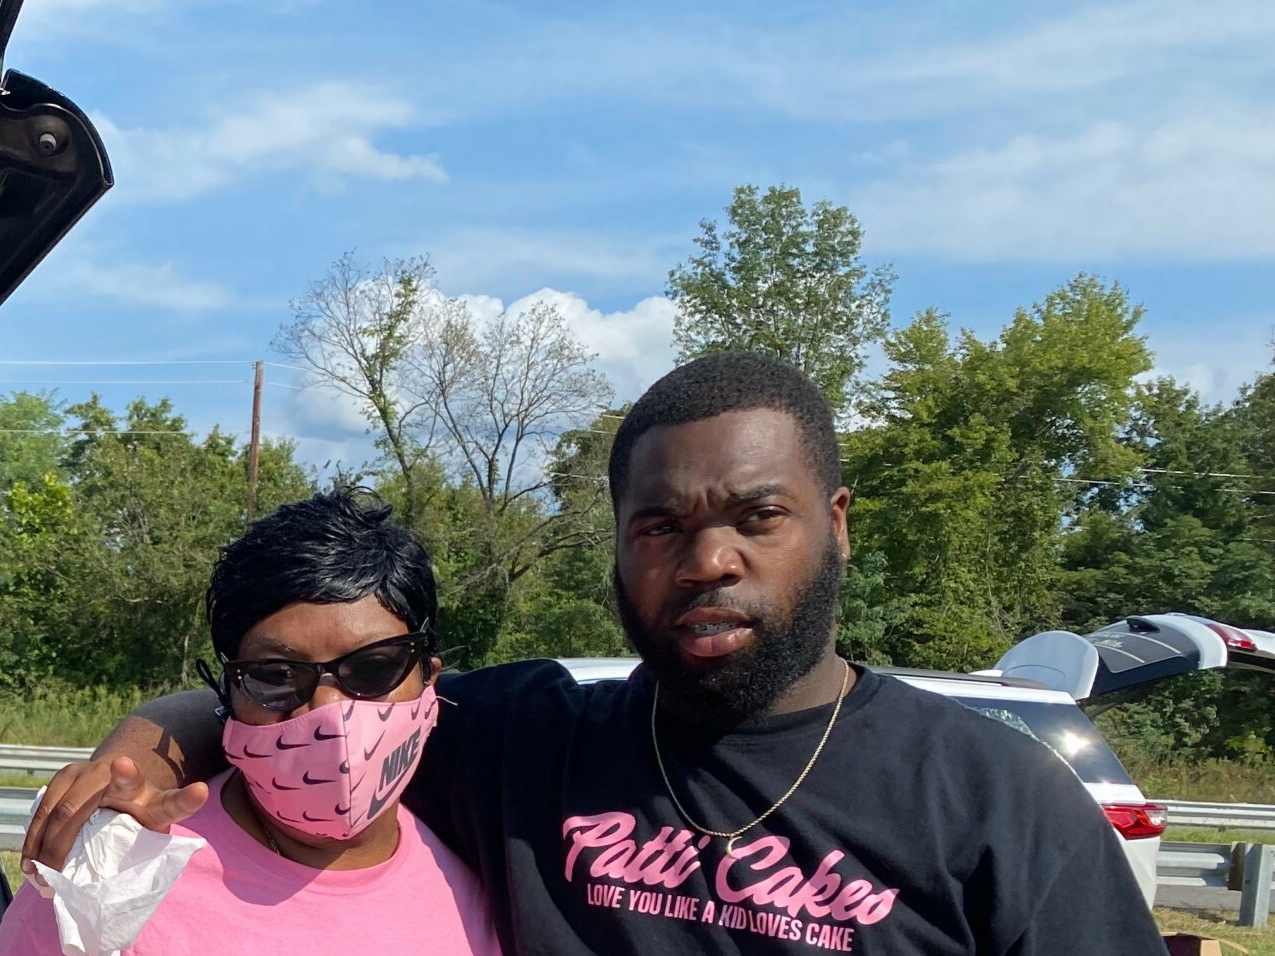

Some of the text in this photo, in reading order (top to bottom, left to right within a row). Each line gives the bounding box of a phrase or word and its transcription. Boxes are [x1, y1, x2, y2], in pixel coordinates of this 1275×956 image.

[378, 725, 421, 792] NIKE
[563, 811, 900, 925] Patti Cakes
[588, 884, 855, 952] LOVE YOU LIKE A KID LOVES CAKE
